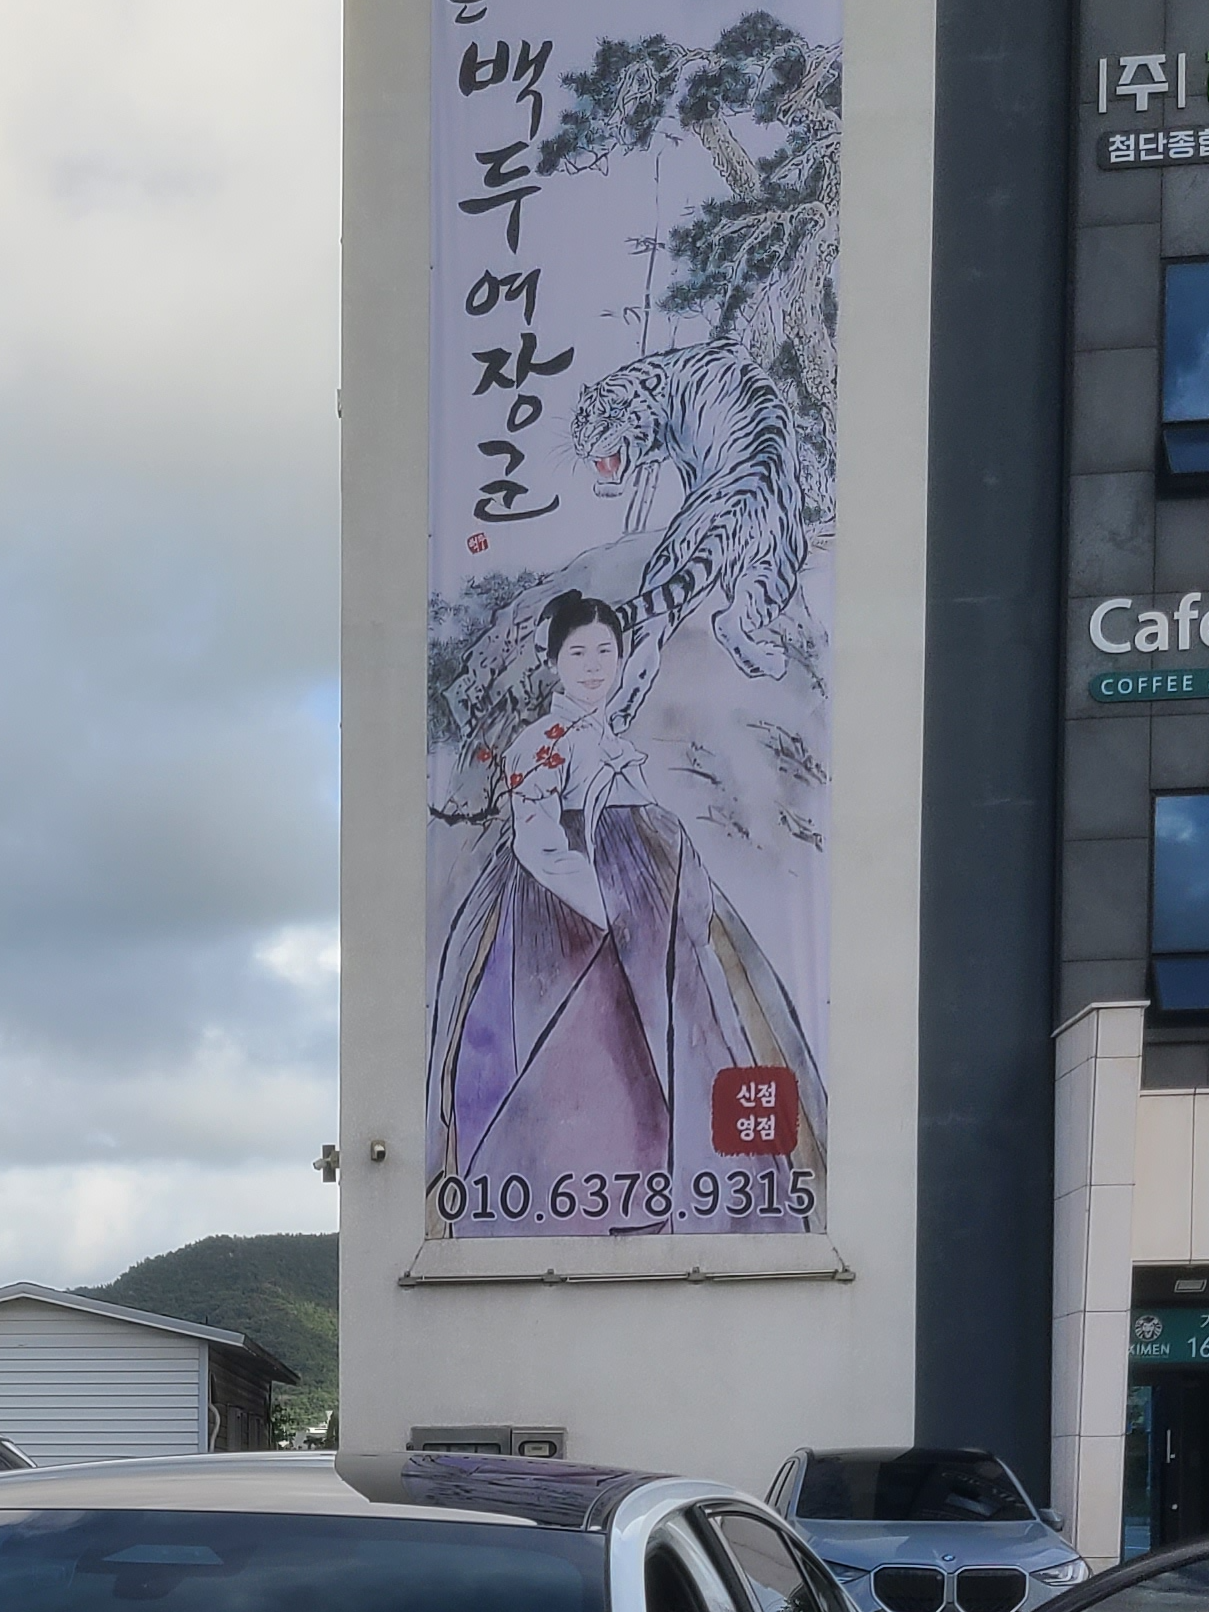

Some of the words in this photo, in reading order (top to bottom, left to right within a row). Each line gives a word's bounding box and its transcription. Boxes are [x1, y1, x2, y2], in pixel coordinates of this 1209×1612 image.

[1100, 675, 1193, 695] COFFEE
[735, 1081, 776, 1107] 신점
[736, 1114, 776, 1141] 영점
[438, 1170, 815, 1222] 010.6378.9315
